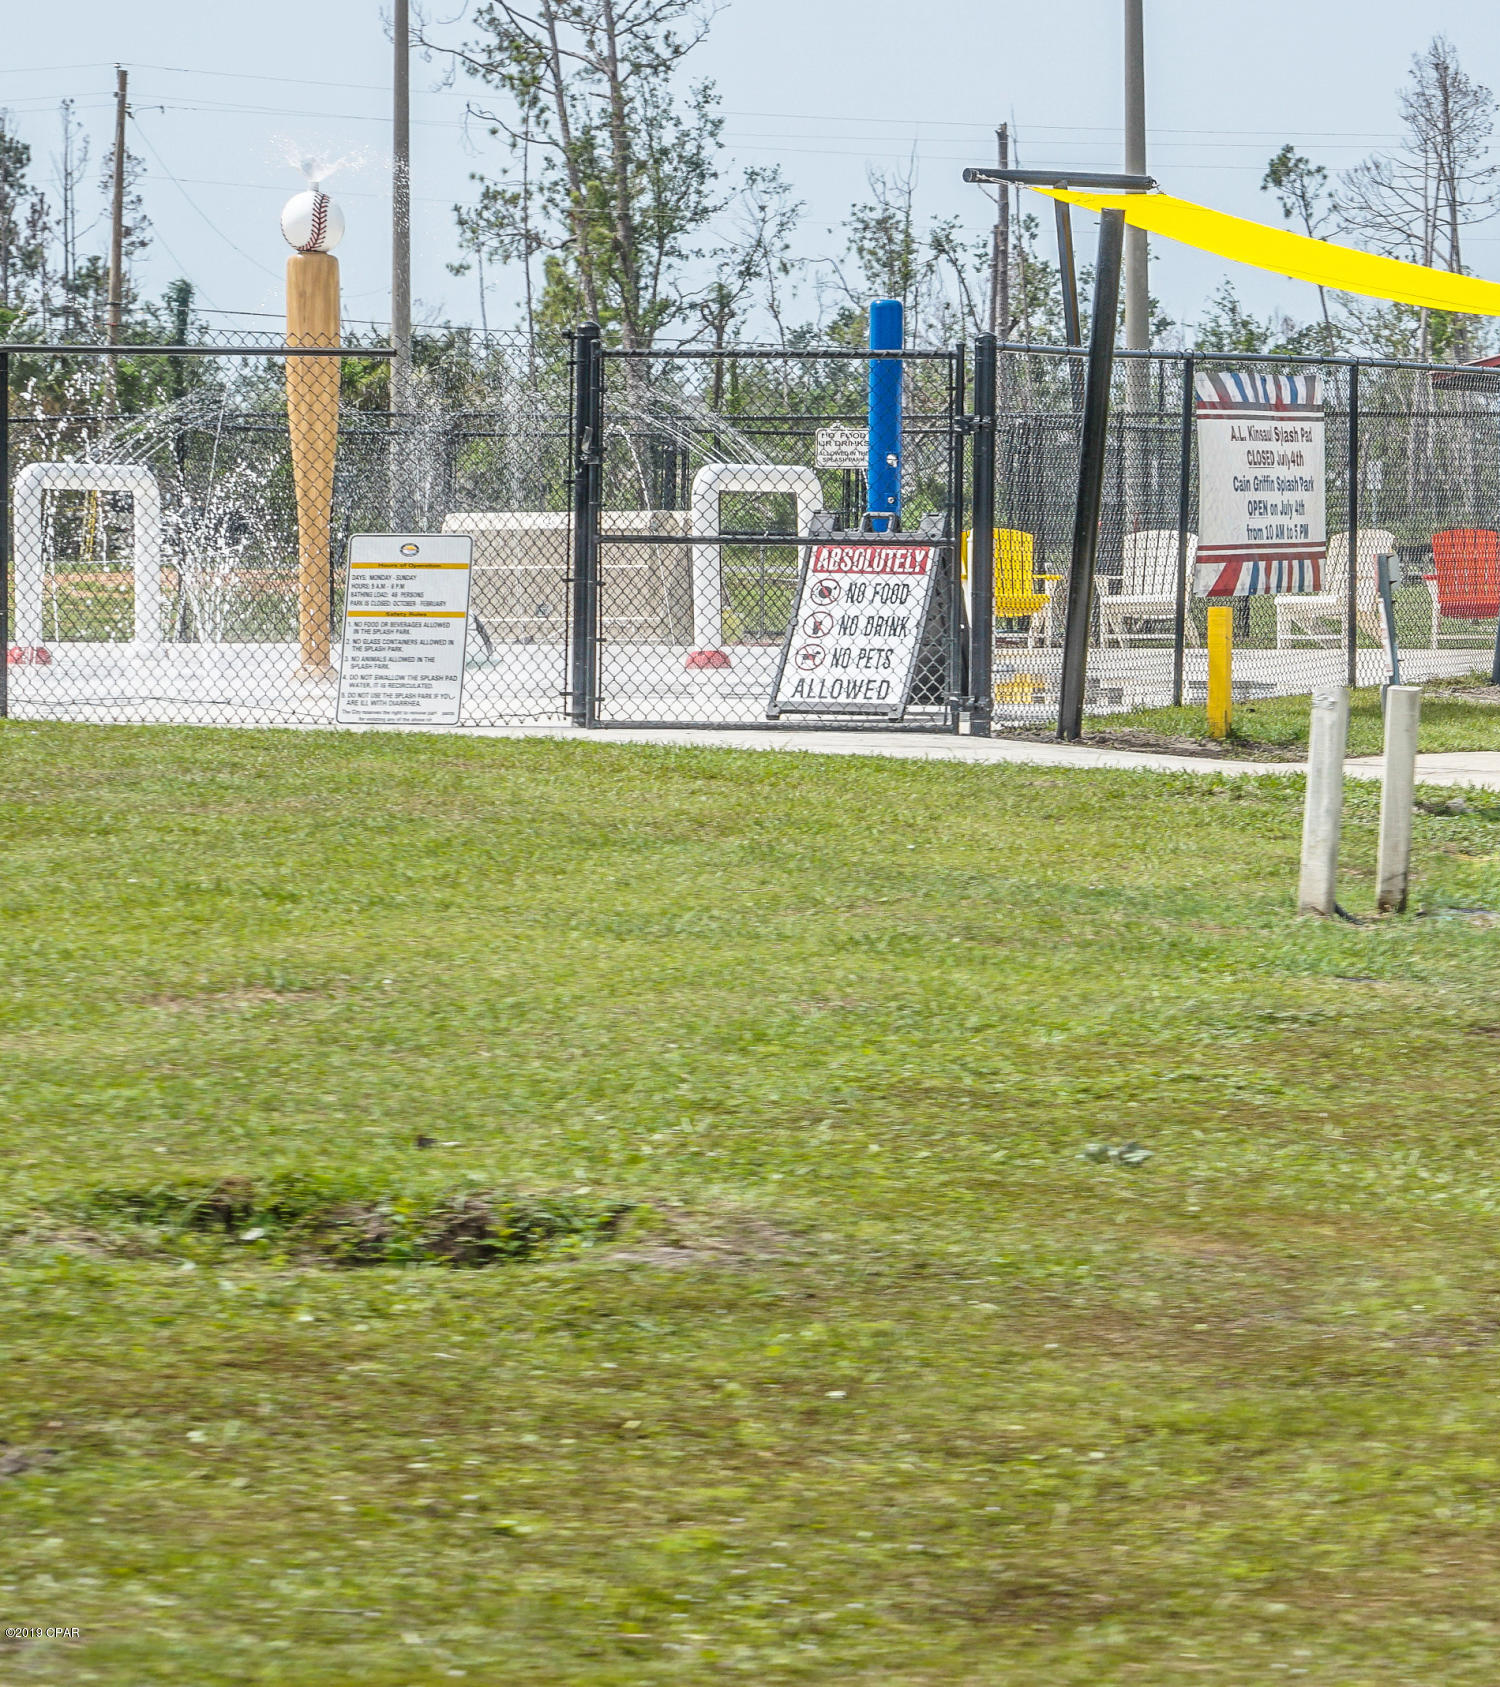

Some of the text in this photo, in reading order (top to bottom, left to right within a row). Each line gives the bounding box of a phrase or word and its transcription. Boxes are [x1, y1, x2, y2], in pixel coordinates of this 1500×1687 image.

[1231, 425, 1246, 441] A.L.
[1274, 426, 1299, 446] Splash
[1301, 426, 1312, 442] Pad
[1247, 449, 1304, 470] CLOSED July 4th
[1233, 475, 1314, 496] Cain Griffin Splash Park
[1247, 499, 1305, 520] OPEN on July 4th
[1247, 524, 1309, 540] from 10 AM to 5 PM
[817, 547, 926, 573] ABSOLUTELY
[846, 582, 910, 605] NO FOOD
[838, 615, 911, 638] NO DRINK
[831, 647, 894, 669] NO PETS
[791, 678, 890, 700] ALLOWED
